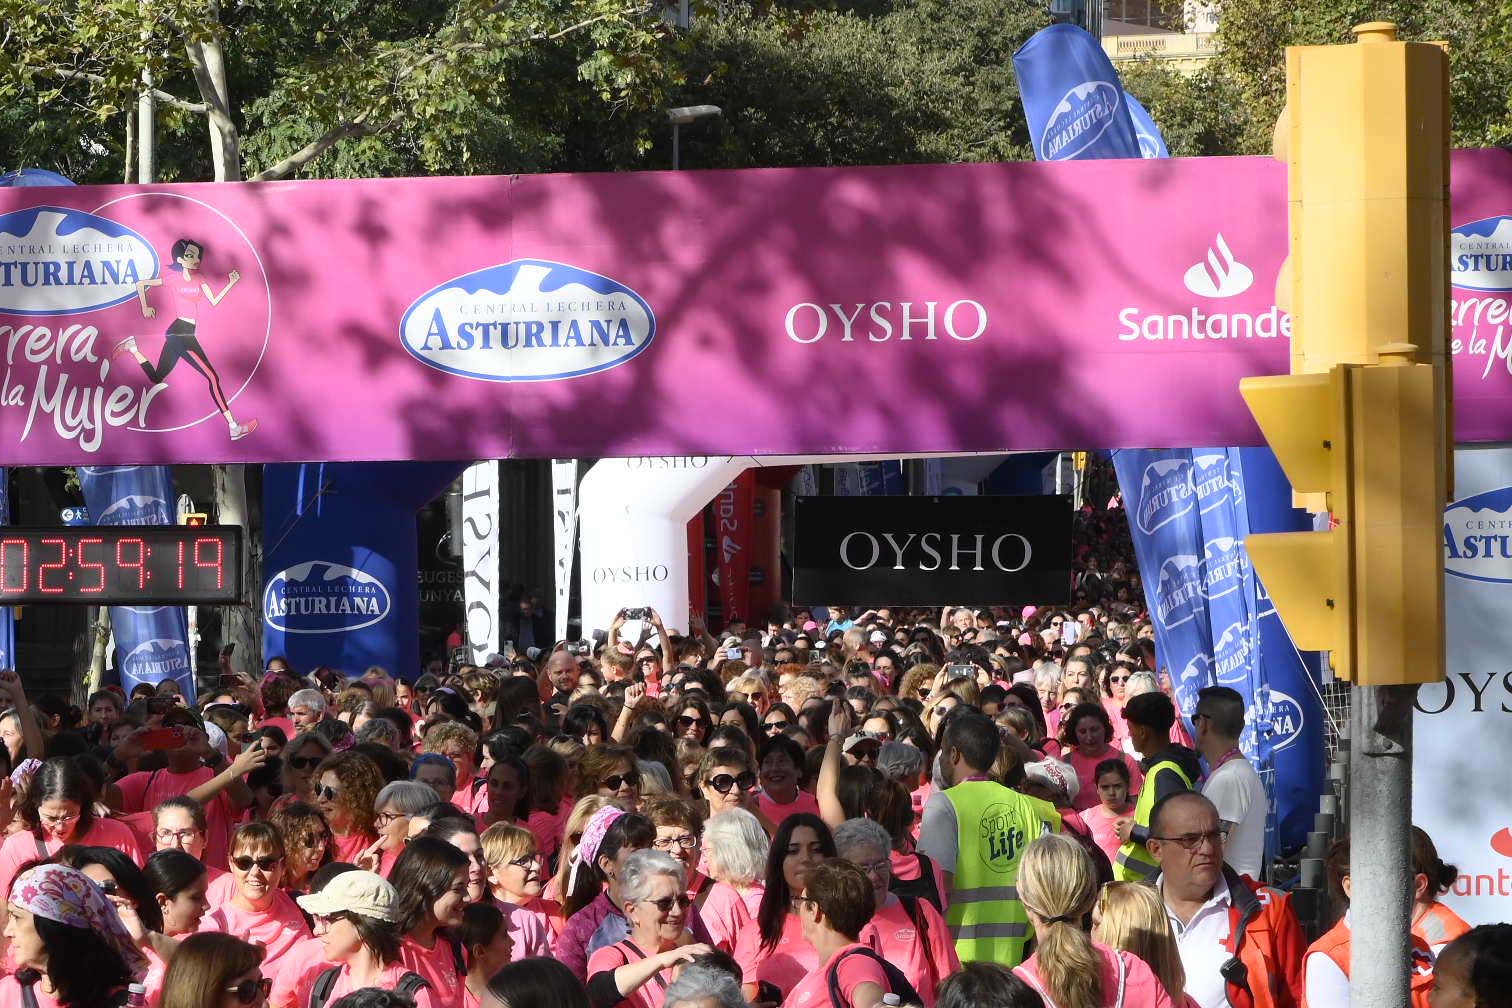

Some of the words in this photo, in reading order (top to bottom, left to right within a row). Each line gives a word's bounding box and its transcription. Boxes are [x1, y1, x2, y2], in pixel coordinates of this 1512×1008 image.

[63, 243, 134, 254] LECHERA
[458, 302, 541, 315] CENTRAL
[548, 300, 627, 313] LECHERA
[785, 299, 988, 344] OYSHO
[1118, 304, 1293, 342] Santande
[420, 307, 636, 351] ASTURIANA
[1468, 325, 1487, 355] la
[0, 368, 25, 406] la
[20, 358, 168, 452] Mujer
[1465, 519, 1512, 530] CENT
[0, 538, 223, 593] 02:59:19
[838, 531, 1033, 572] OYSHO
[281, 586, 324, 595] CENTRAL
[327, 586, 377, 595] LECHERA
[593, 564, 668, 585] OYSHO
[268, 594, 381, 617] ASTURIANA
[1414, 671, 1512, 714] OYS
[981, 808, 1017, 839] Sport
[988, 827, 1025, 861] Life
